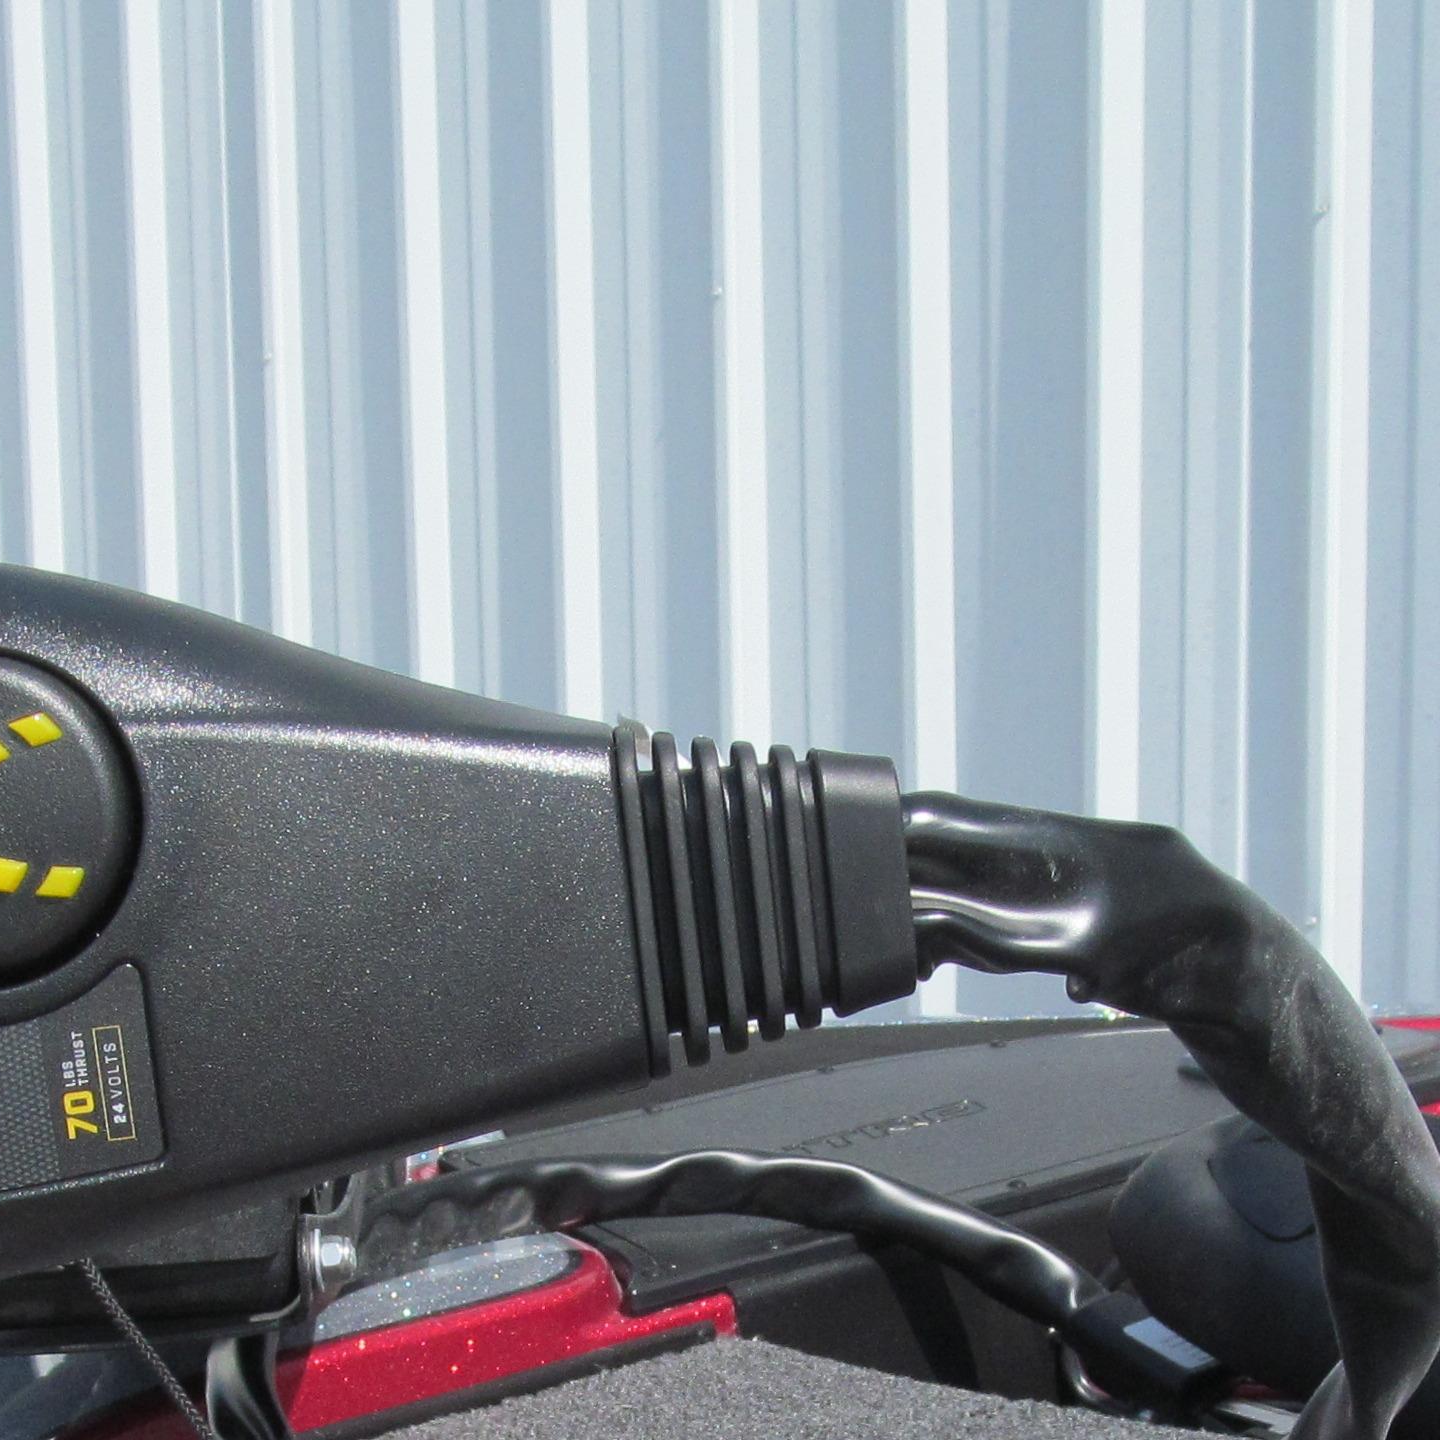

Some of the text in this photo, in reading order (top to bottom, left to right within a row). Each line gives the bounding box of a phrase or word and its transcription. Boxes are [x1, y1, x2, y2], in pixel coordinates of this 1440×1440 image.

[71, 1031, 89, 1086] THRUST
[103, 1042, 127, 1124] 24 VOLTS
[62, 1061, 98, 1139] 70 LBS
